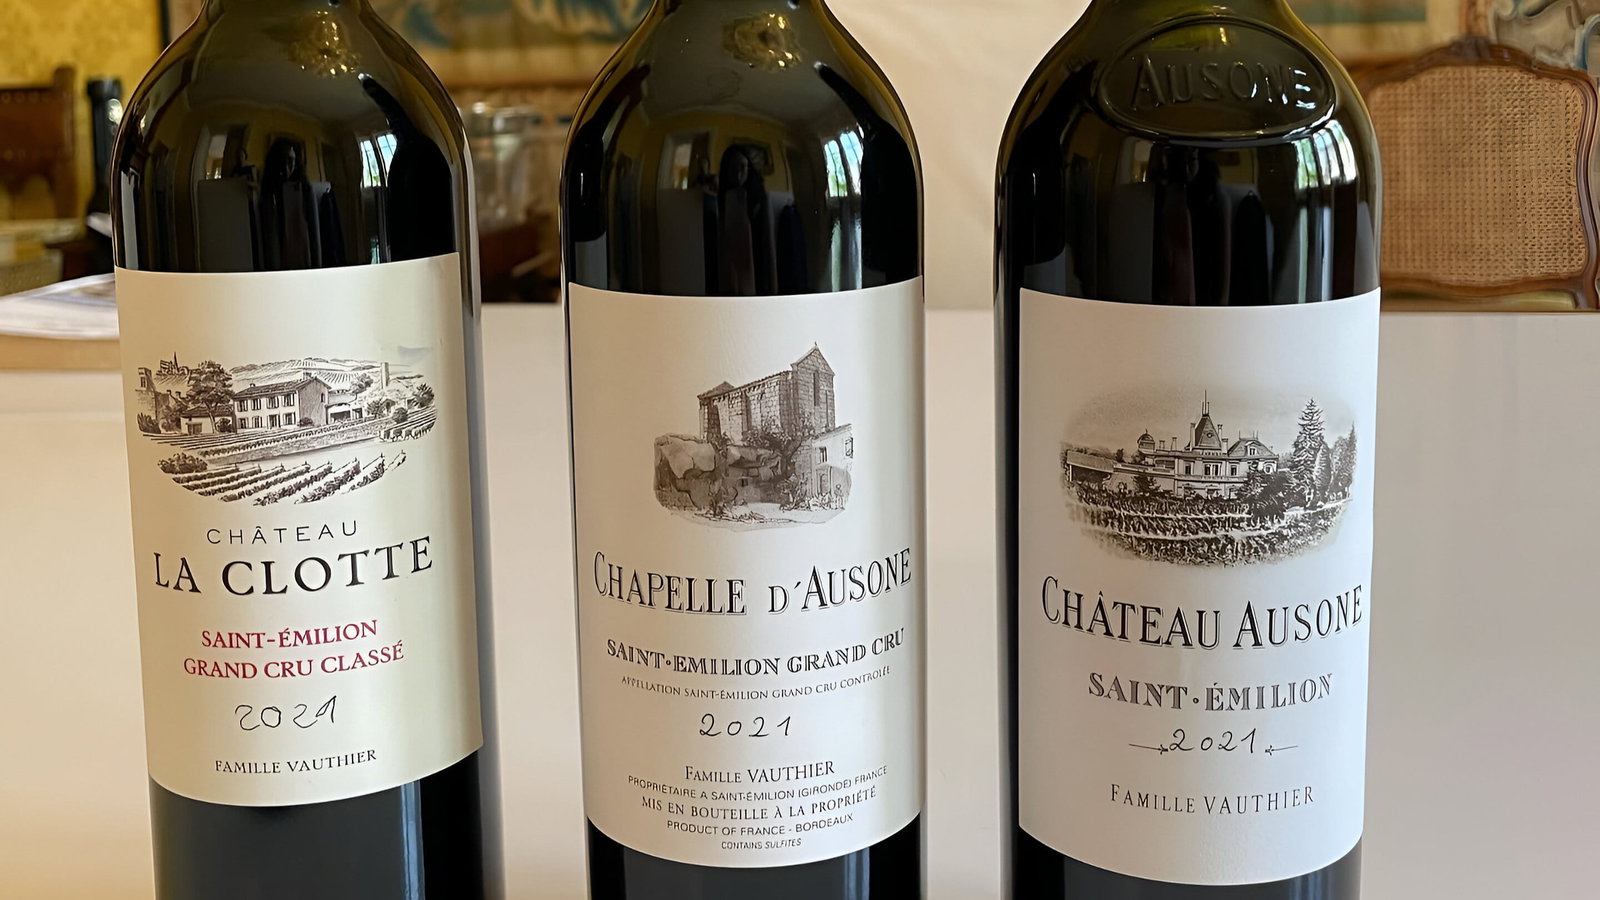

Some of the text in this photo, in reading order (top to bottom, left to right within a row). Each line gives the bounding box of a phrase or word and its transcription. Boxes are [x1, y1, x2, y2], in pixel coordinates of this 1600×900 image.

[1131, 55, 1316, 112] AUSONE
[206, 520, 358, 544] CHÂTEAU
[153, 536, 433, 596] LA CLOTTE
[594, 551, 746, 616] CHAPELLE
[1042, 576, 1362, 650] CHÂTEAU AUSONE
[201, 620, 378, 648] SAINT-ÉMILION
[184, 640, 404, 679] GRAND CRU CLASSÉ
[787, 644, 866, 673] GRAND
[872, 628, 904, 656] CRU
[622, 676, 680, 696] APPELLATION
[684, 688, 768, 700] SAINT-ÉMILION
[772, 686, 812, 698] GRAND
[816, 682, 837, 694] CRU
[235, 695, 337, 730] 2021
[700, 714, 792, 738] 2021
[1169, 728, 1256, 754] 2021
[215, 750, 376, 774] FAMILLE VAUTHIER
[685, 760, 835, 784] FAMILLE VAUTHIER
[700, 791, 708, 800] A
[711, 790, 794, 801] SAINT-ÉMILION
[798, 779, 852, 798] (GIRONDE)
[854, 765, 888, 786] FRANCE
[642, 796, 662, 811] MIS
[668, 802, 684, 814] EN
[691, 806, 768, 820] BOUTEILLE
[790, 805, 805, 817] LA
[812, 785, 876, 814] PROPRIÉTÉ
[1111, 784, 1314, 814] FAMILLE VAUTHIER
[667, 820, 718, 834] PRODUCT
[722, 827, 736, 836] OF
[740, 826, 786, 836] FRANCE
[796, 813, 853, 832] BORDEAUX
[721, 838, 802, 850] CONTAINS SULFITES
